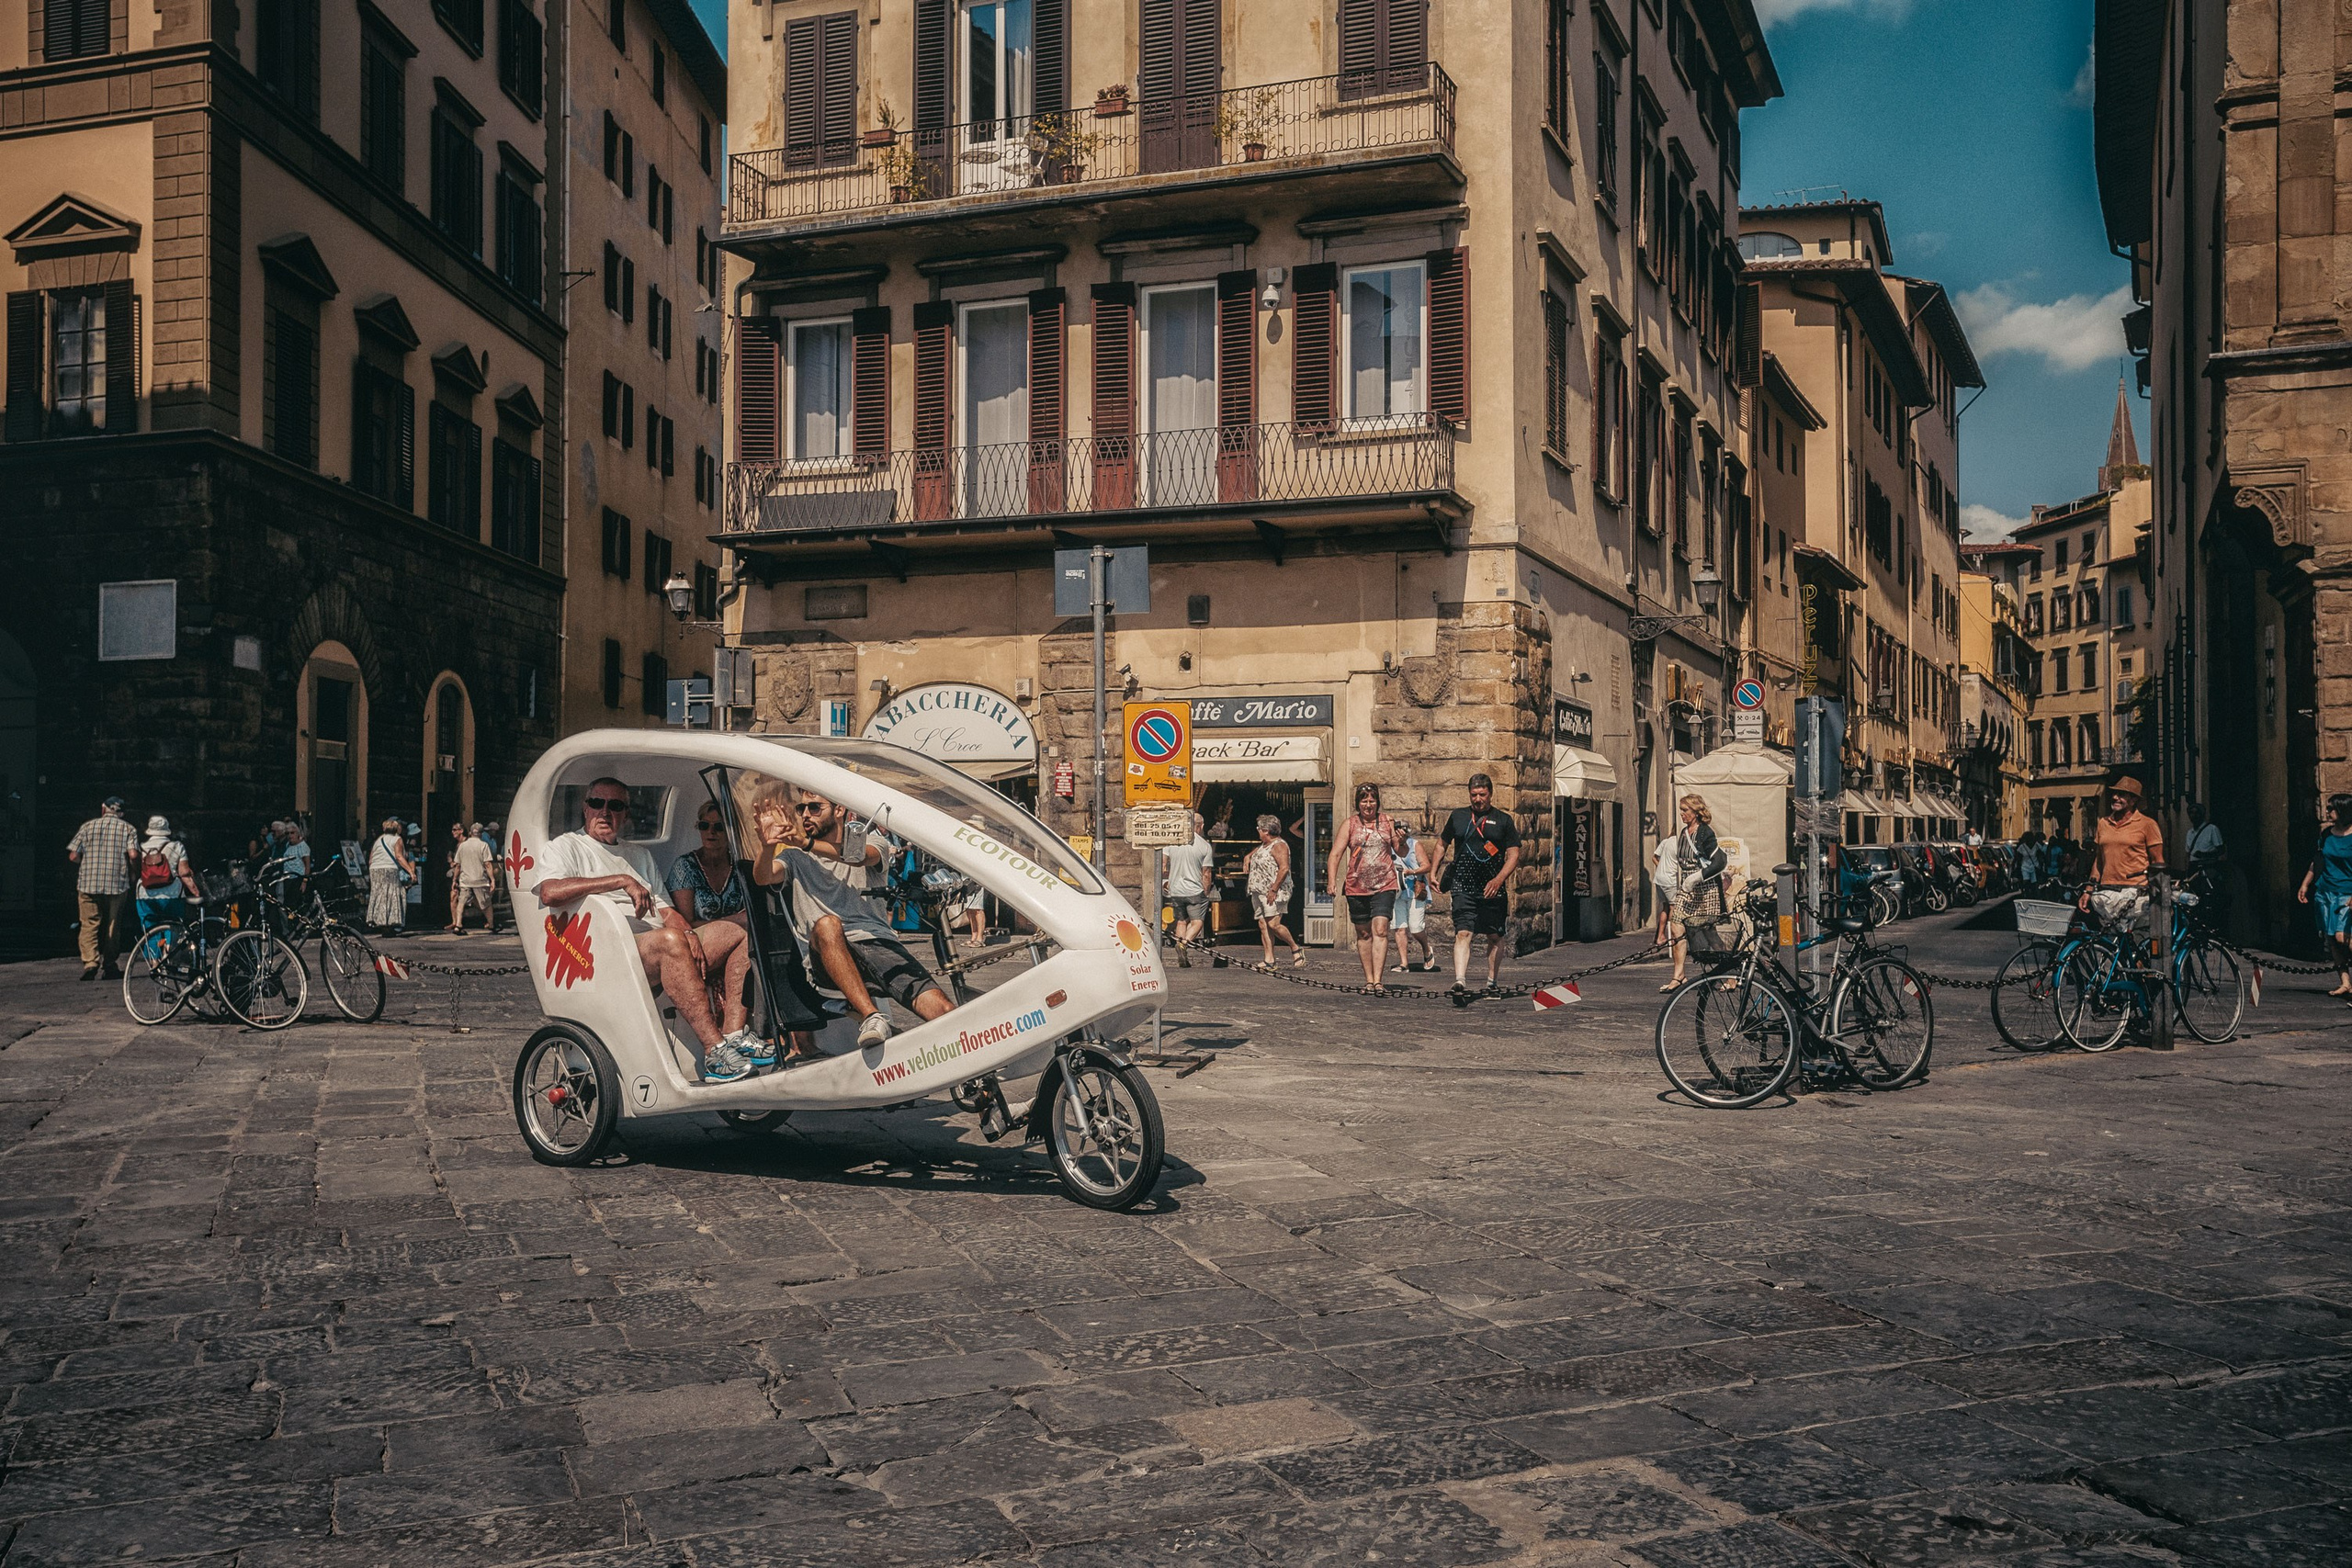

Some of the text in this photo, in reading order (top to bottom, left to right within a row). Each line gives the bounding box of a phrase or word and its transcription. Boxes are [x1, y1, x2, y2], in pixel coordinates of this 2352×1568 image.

[1802, 583, 1818, 697] Peruzz
[867, 690, 1028, 751] ABACCHERIA
[1234, 700, 1317, 724] Mario
[939, 727, 983, 752] Croce
[1192, 740, 1290, 758] ack Bar
[1575, 815, 1588, 870] PANINI
[953, 827, 1061, 892] ECOTOUR
[565, 942, 591, 969] ENERGY
[1130, 964, 1152, 976] Solar
[1131, 979, 1159, 992] Energy
[873, 1008, 1047, 1088] www.velotourflorence.com
[639, 1083, 650, 1102] 7
